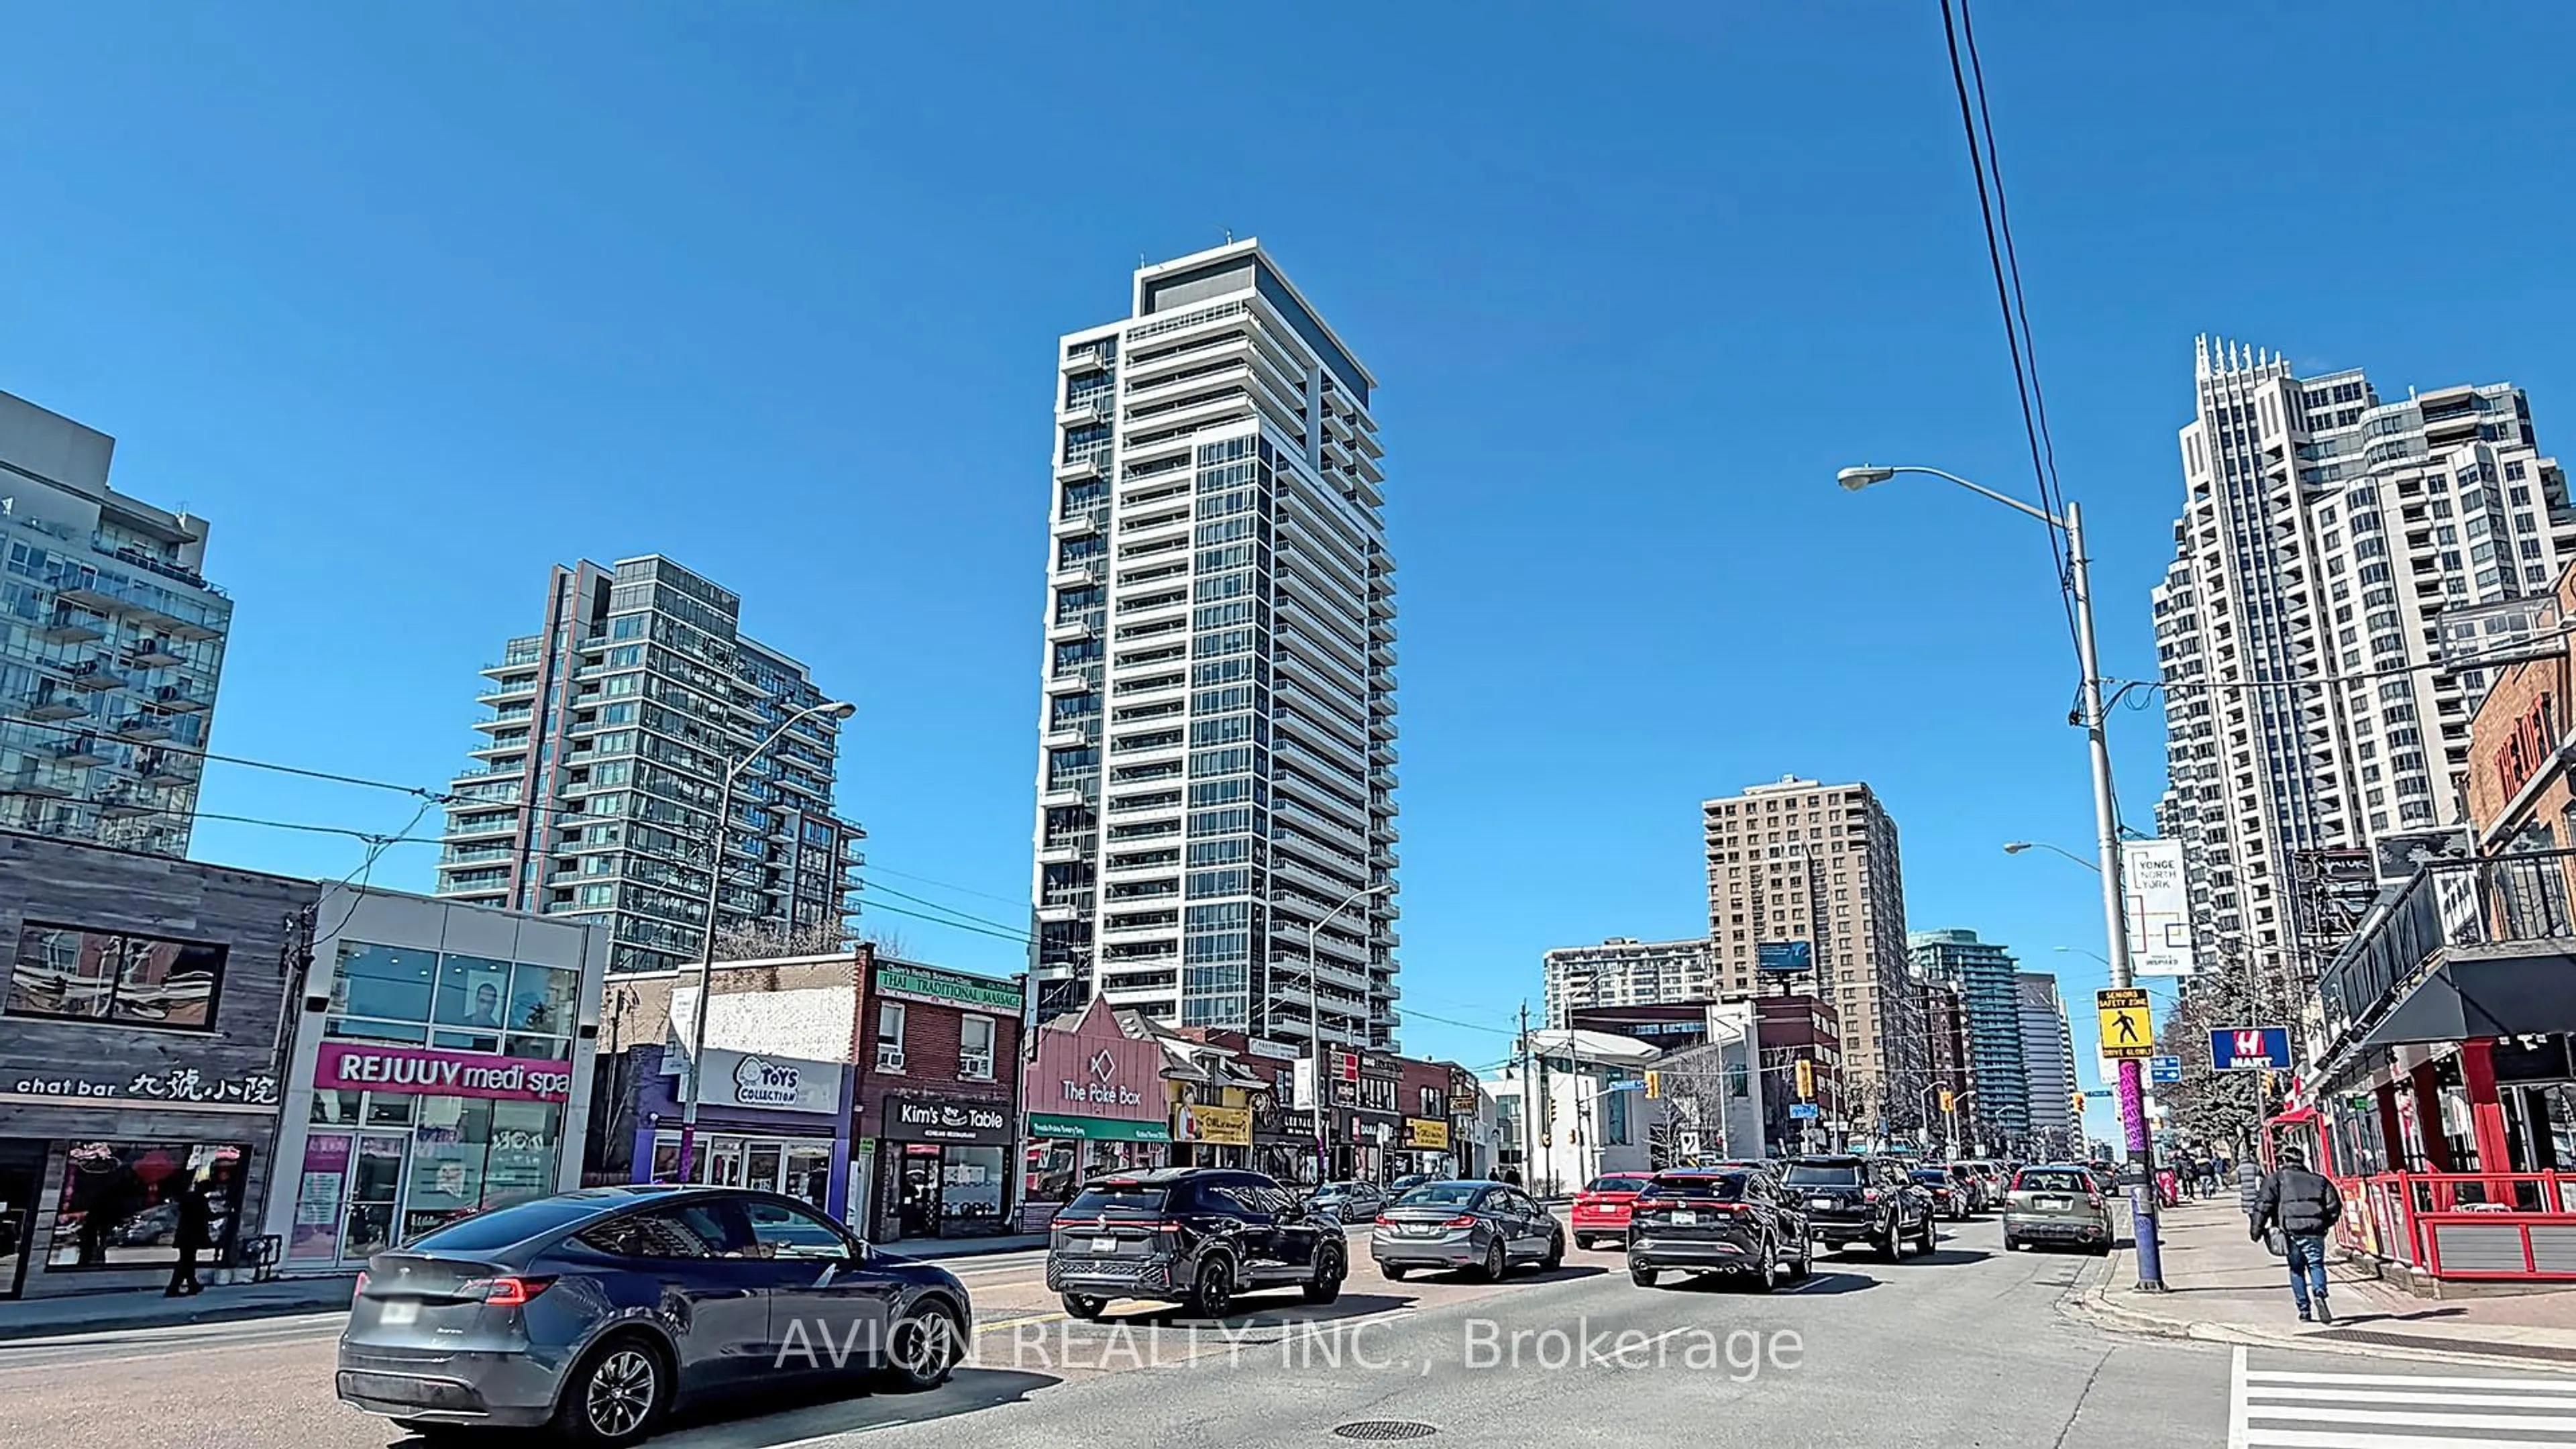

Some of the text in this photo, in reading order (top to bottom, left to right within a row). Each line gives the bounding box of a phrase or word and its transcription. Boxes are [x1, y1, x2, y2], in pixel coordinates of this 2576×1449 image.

[2494, 693, 2551, 806] THE LOFT
[2140, 860, 2176, 869] YONGE
[2141, 871, 2177, 879] NORTH
[2142, 880, 2171, 889] YORK
[883, 973, 907, 988] THAI
[917, 979, 978, 1000] TRADITIONAL
[983, 991, 1020, 1008] MASSAGE
[2230, 1057, 2273, 1068] MART
[339, 1054, 570, 1099] REJUUV medi spa
[17, 1078, 117, 1097] chat bar
[740, 1088, 796, 1102] COLLECTION
[1063, 1081, 1141, 1106] The Poké Box
[902, 1104, 1004, 1129] Kim's Table
